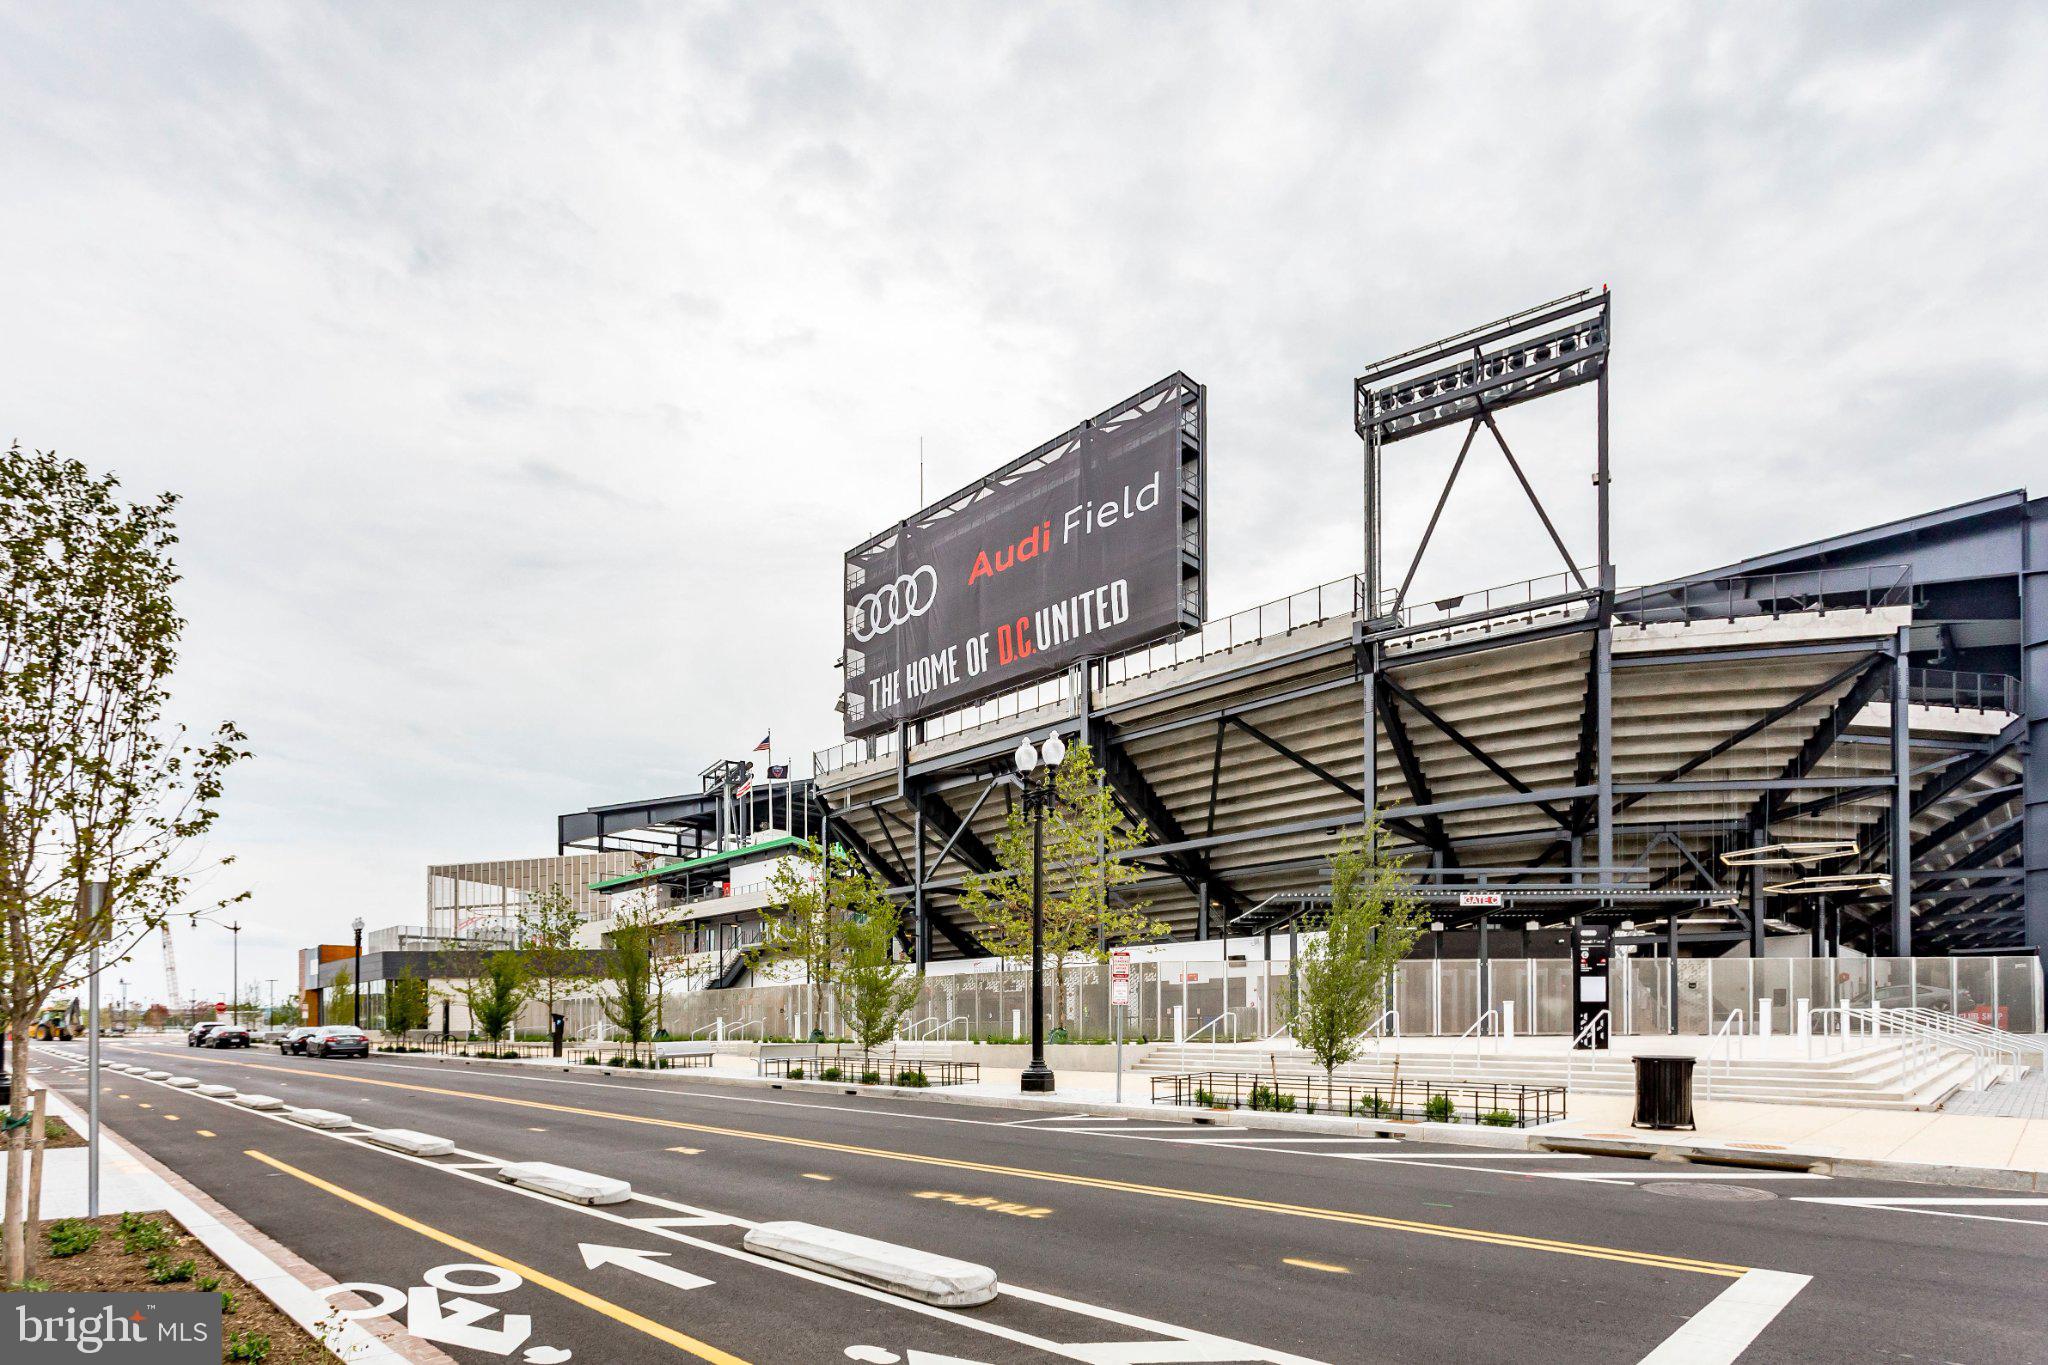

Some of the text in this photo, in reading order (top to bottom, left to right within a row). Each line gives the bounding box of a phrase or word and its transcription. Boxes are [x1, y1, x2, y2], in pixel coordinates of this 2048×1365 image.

[968, 471, 1160, 585] Audi Field
[870, 668, 901, 713] THE
[906, 645, 960, 699] HOME
[966, 632, 990, 677] OF
[1464, 895, 1489, 904] GATE
[1982, 1012, 2003, 1021] SHP
